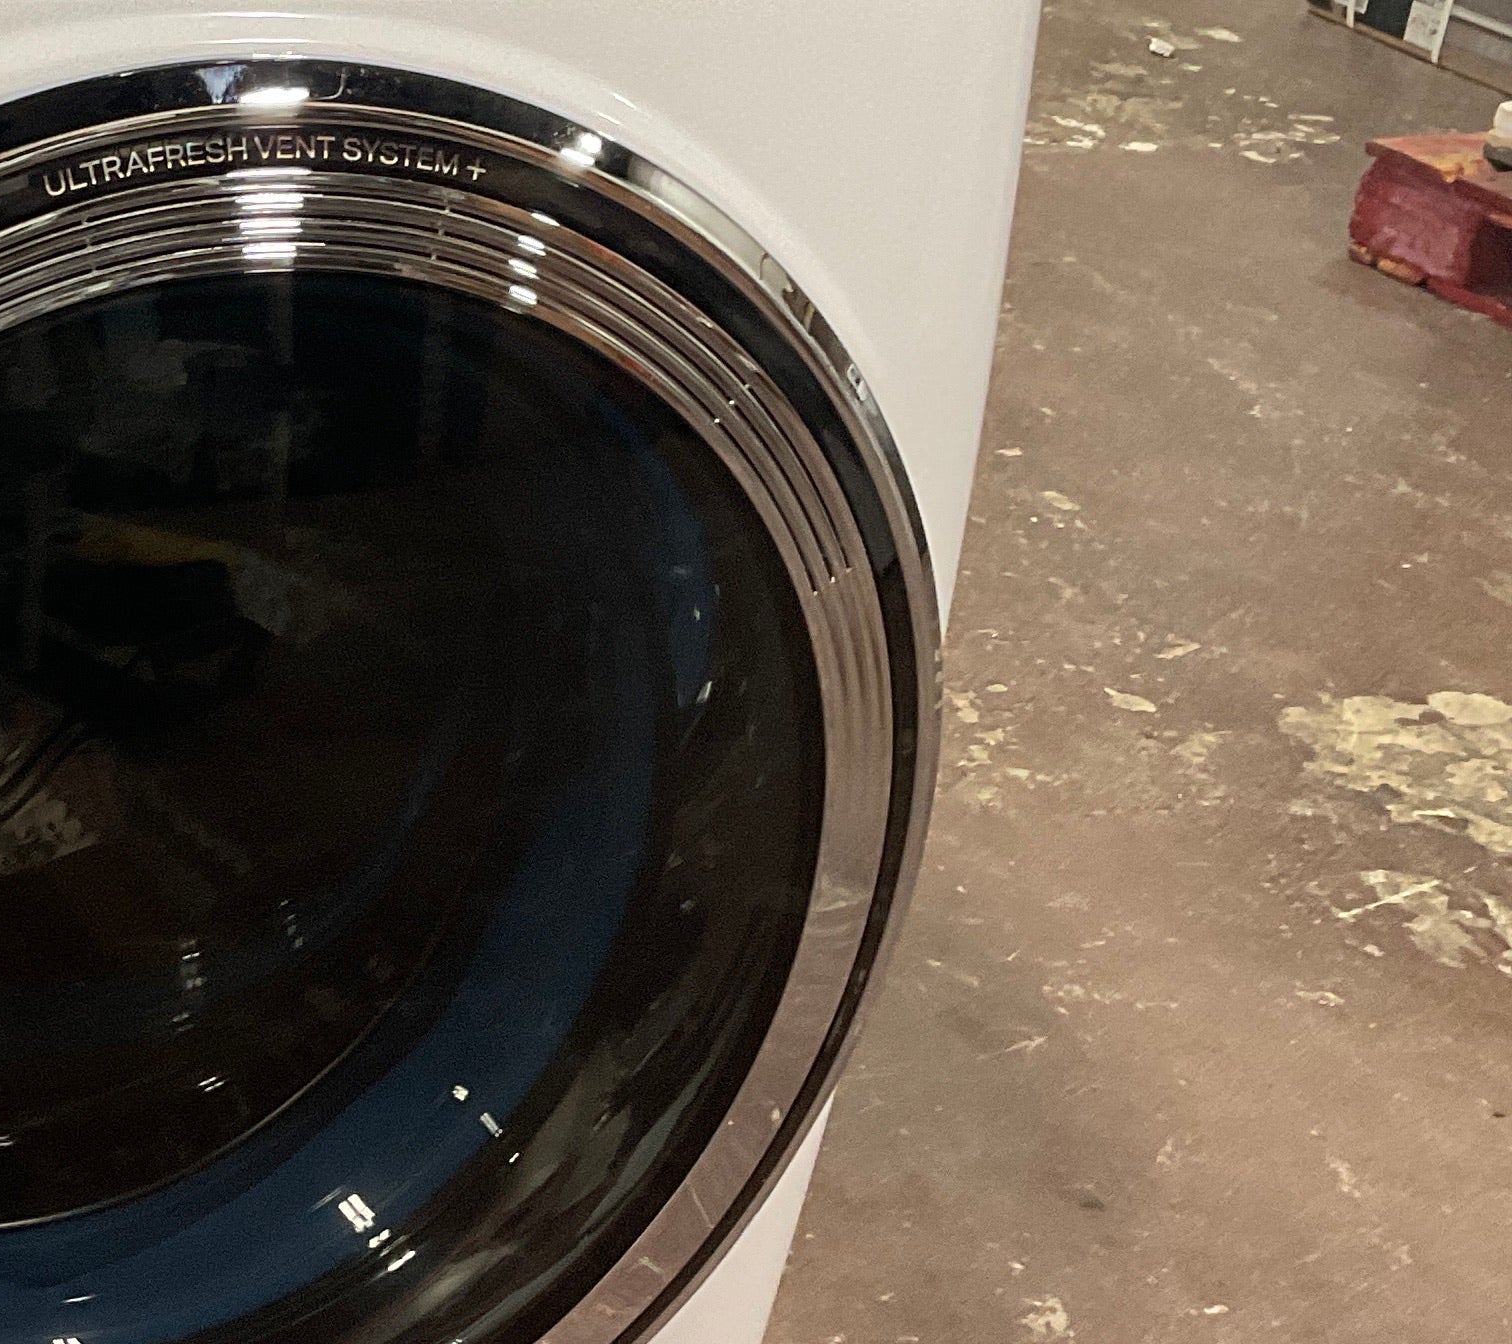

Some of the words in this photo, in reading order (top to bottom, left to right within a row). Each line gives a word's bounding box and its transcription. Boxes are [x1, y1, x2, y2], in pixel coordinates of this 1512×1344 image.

[42, 136, 249, 197] ULTRAFRESH
[253, 135, 336, 160] VENT
[341, 136, 462, 177] SYSTEM
